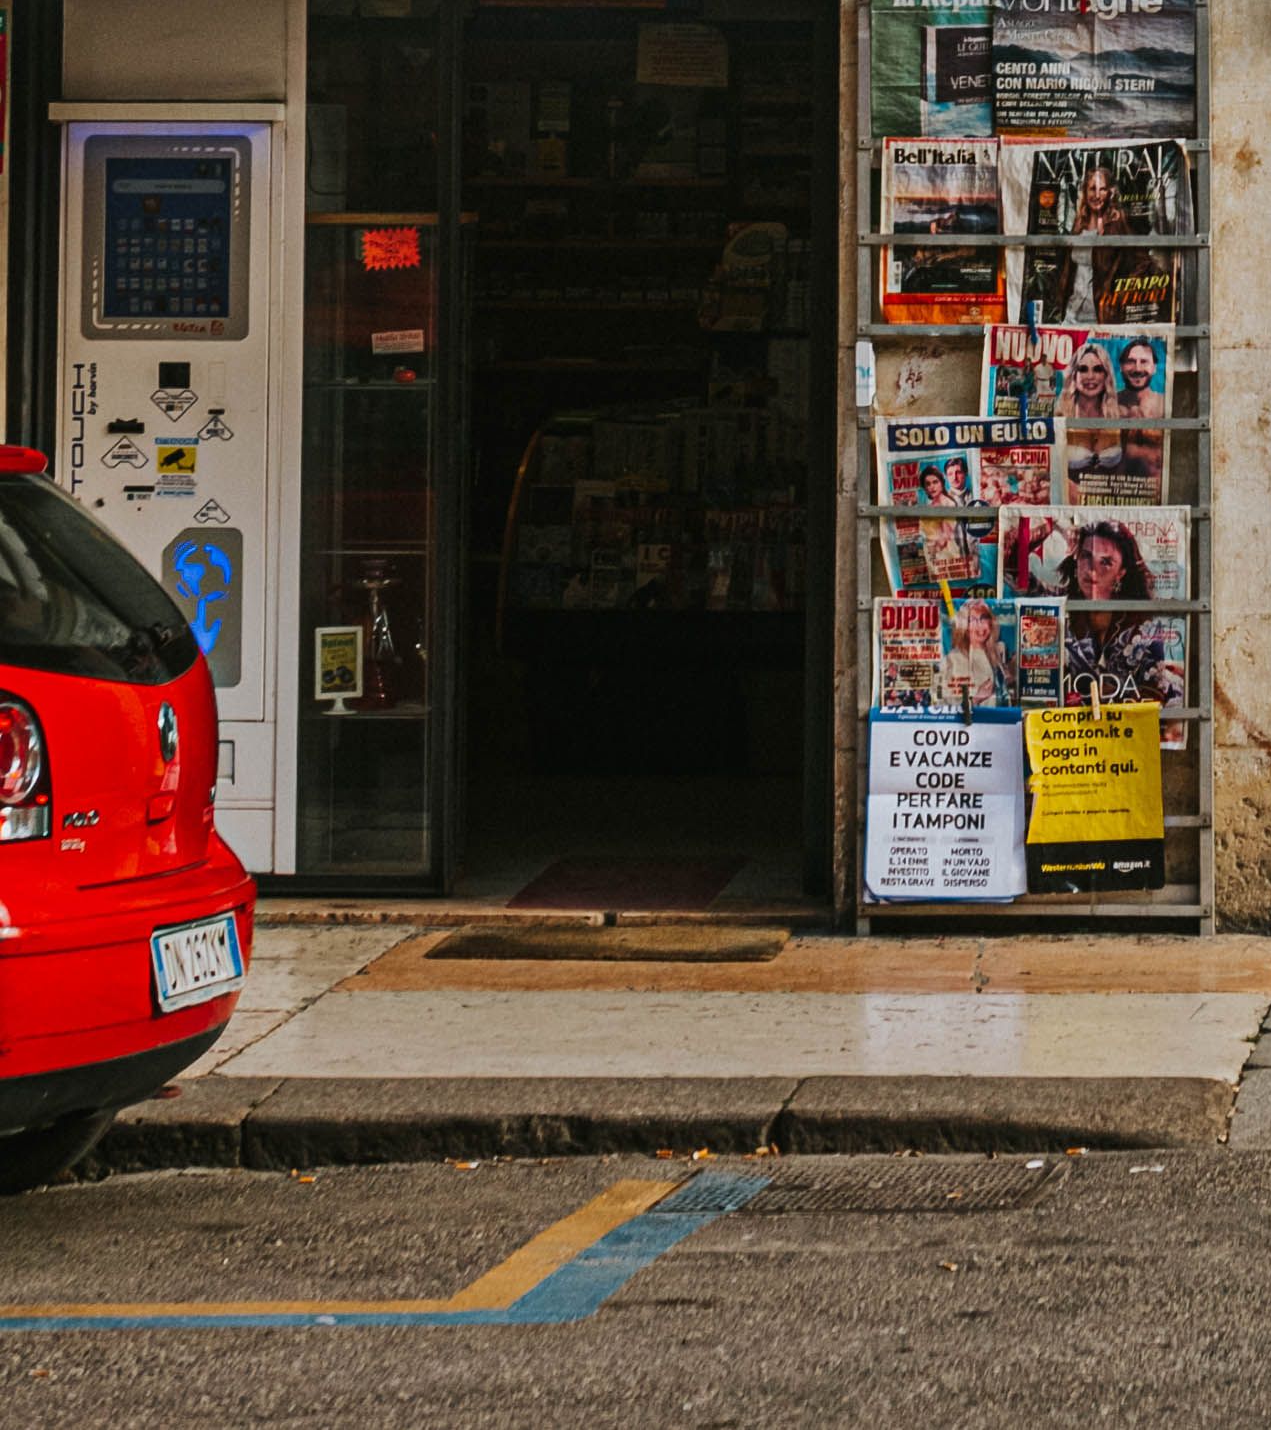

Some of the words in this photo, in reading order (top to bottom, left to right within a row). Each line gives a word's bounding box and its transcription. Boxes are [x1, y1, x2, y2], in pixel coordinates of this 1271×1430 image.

[995, 61, 1036, 75] CENTO
[1039, 62, 1071, 75] ANNI
[995, 77, 1024, 90] CON
[1025, 77, 1067, 90] MARIO
[1070, 78, 1112, 91] RIGONI
[1114, 78, 1155, 92] STERN
[894, 148, 977, 166] Bell'Italia
[1114, 273, 1170, 292] TEMPO
[87, 400, 98, 416] by
[71, 363, 86, 494] TOUCH
[895, 425, 951, 447] SOLO
[955, 423, 984, 444] UN
[1009, 449, 1048, 465] CUCINA
[1106, 711, 1122, 721] su
[913, 730, 970, 746] COVID
[1041, 725, 1120, 741] Amazon.it
[1123, 728, 1134, 738] e
[889, 751, 900, 767] E
[904, 751, 993, 768] VACANZE
[1042, 747, 1080, 761] paga
[1084, 743, 1098, 756] in
[1042, 763, 1106, 776] contanti
[1110, 759, 1139, 777] qui.
[916, 772, 965, 789] CODE
[897, 792, 931, 808] PER
[936, 793, 984, 809] FARE
[893, 813, 898, 829] I
[902, 813, 985, 830] TAMPONI
[890, 847, 928, 855] OPERATO
[951, 848, 983, 856] MORTO
[888, 868, 930, 876] INVESTITO
[950, 869, 990, 877] GIOVANE
[880, 878, 907, 887] RESTA
[907, 878, 935, 887] GRAVE
[943, 879, 988, 887] DISPERSO
